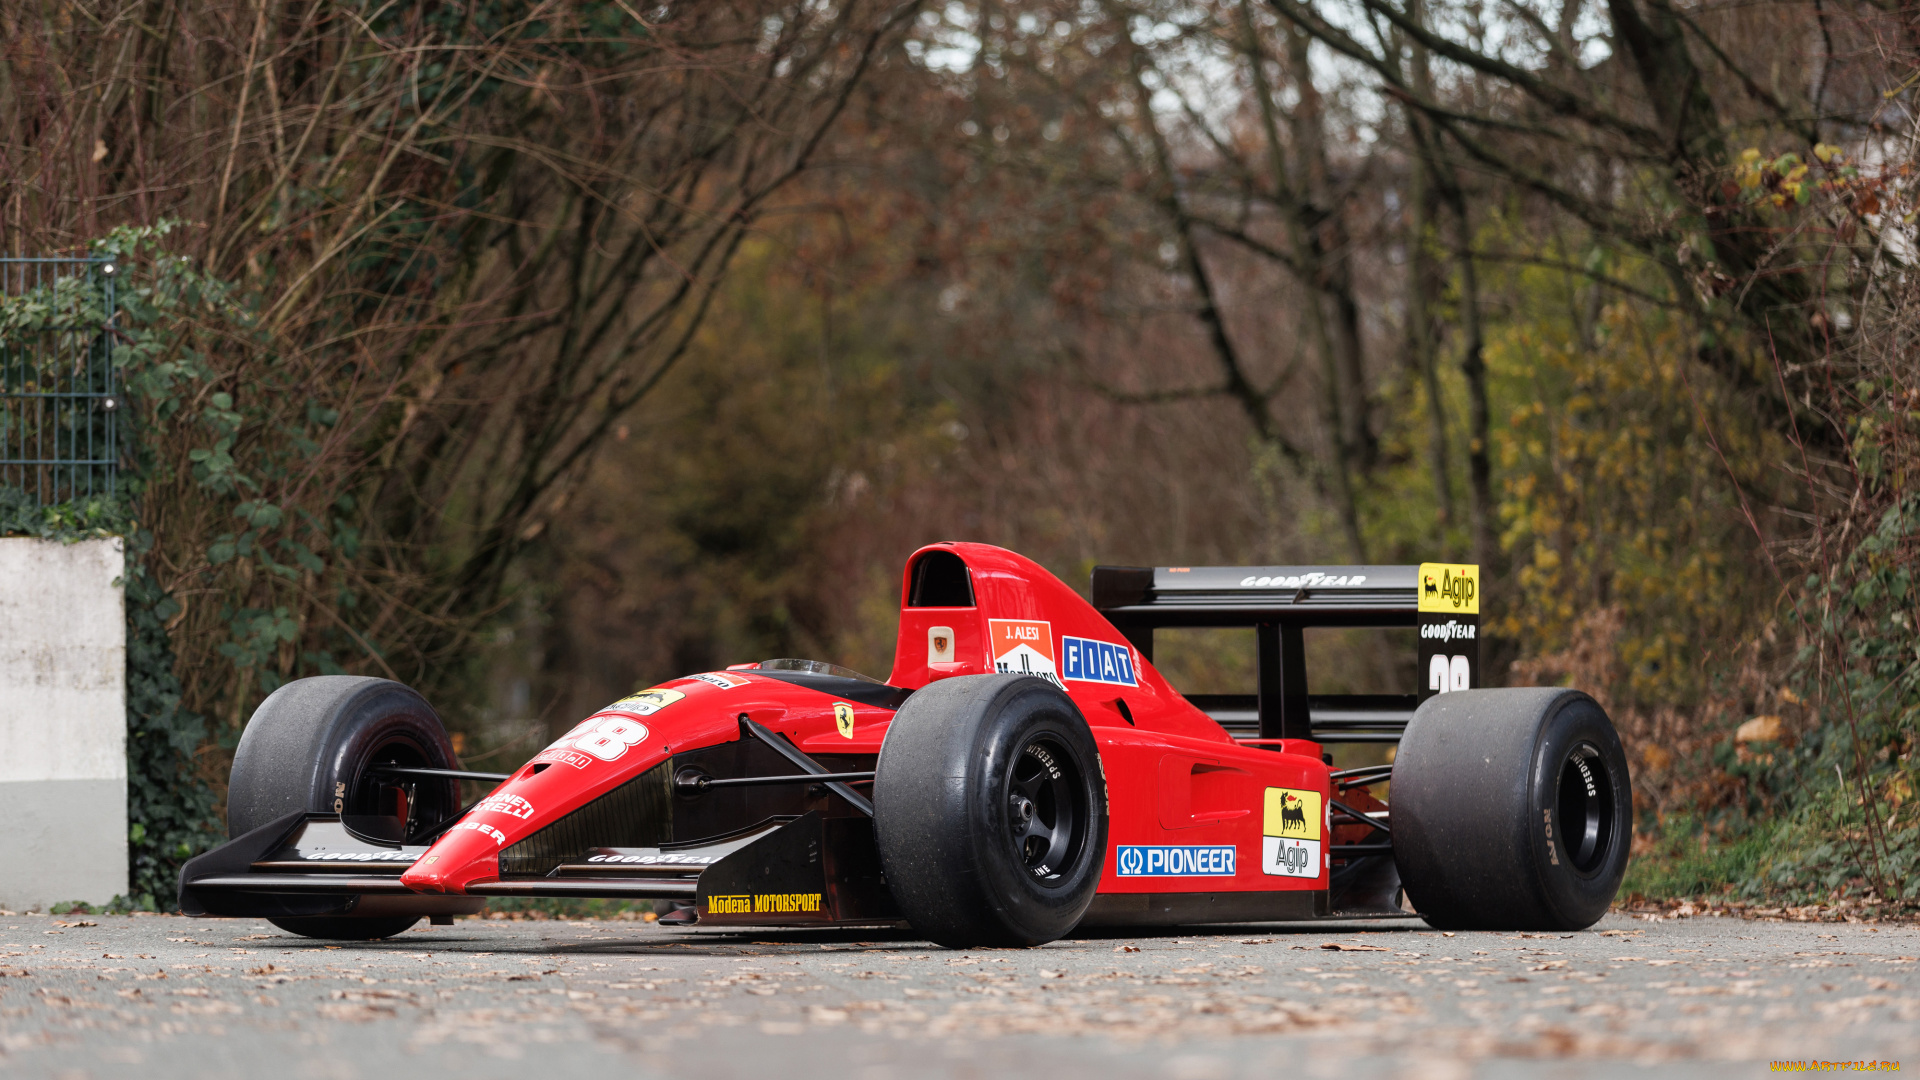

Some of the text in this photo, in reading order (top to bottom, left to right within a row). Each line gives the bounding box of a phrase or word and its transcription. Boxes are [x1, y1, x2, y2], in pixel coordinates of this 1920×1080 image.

[1240, 572, 1367, 588] GOODYEAR
[1441, 568, 1475, 608] Agip
[1006, 626, 1039, 640] J. ALESI
[1421, 620, 1476, 643] GOODYEAR
[1069, 645, 1129, 679] FIAT
[1026, 744, 1062, 780] SPEEDLIN
[1570, 752, 1597, 797] SPEEDLINE
[446, 822, 506, 846] EBER
[306, 851, 425, 862] GOODYEA
[587, 853, 724, 864] GOODYEA
[1147, 849, 1234, 874] PIONEER
[1275, 839, 1309, 873] Agip
[754, 893, 822, 912] MOTORSPORT
